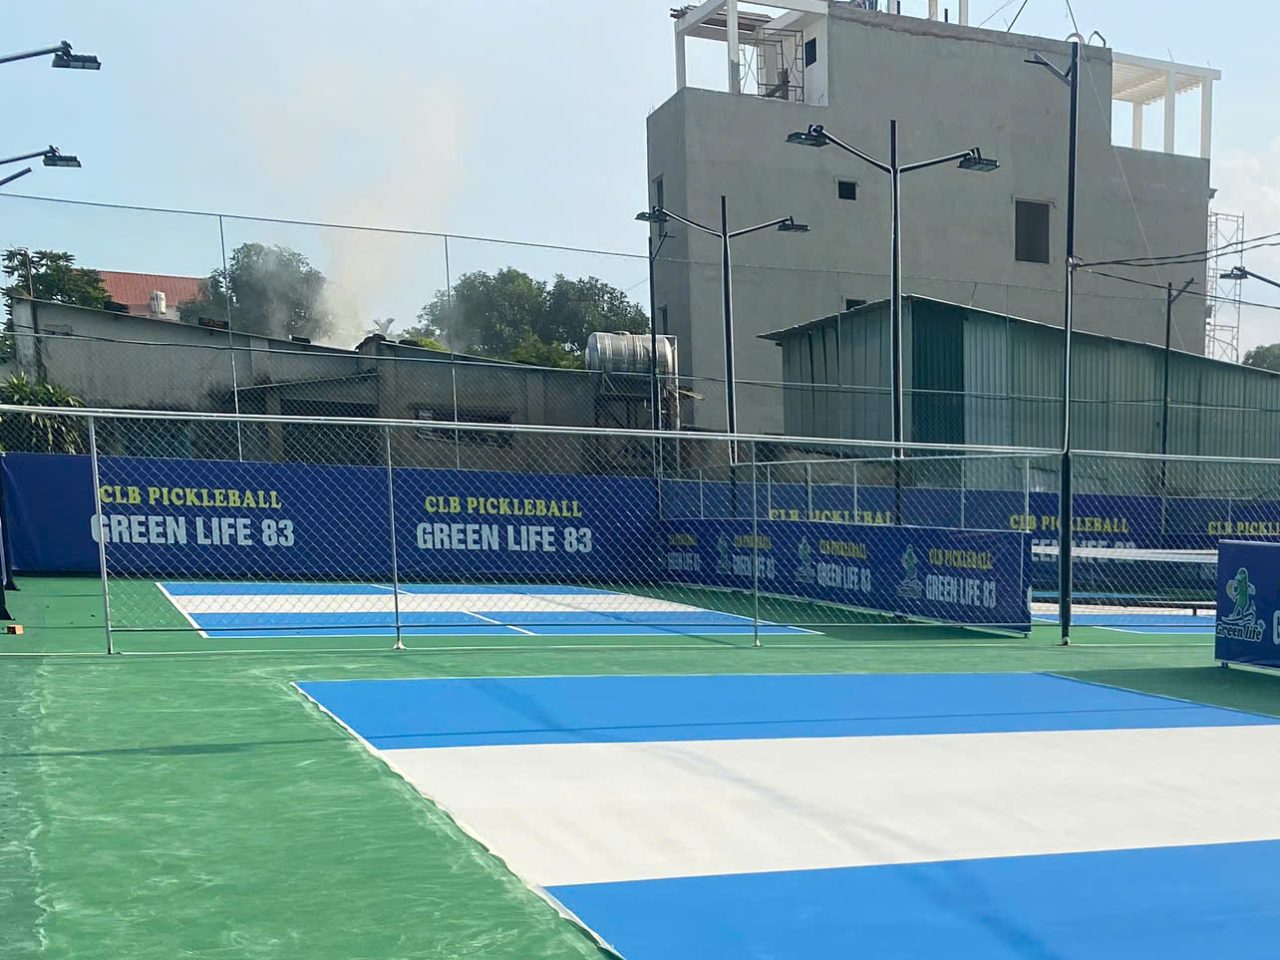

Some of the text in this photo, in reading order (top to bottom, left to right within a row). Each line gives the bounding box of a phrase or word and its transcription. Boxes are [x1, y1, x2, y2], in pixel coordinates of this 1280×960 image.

[99, 485, 282, 509] CLB PICKLEBALL
[425, 496, 582, 517] CLB PICKLEBALL
[91, 513, 294, 547] GREEN LIFE 83
[416, 522, 592, 553] GREEN LIFE 83
[1042, 515, 1130, 533] PILEBALL
[926, 574, 957, 602] GREEN
[960, 578, 981, 606] LIFE
[983, 580, 996, 608] 83
